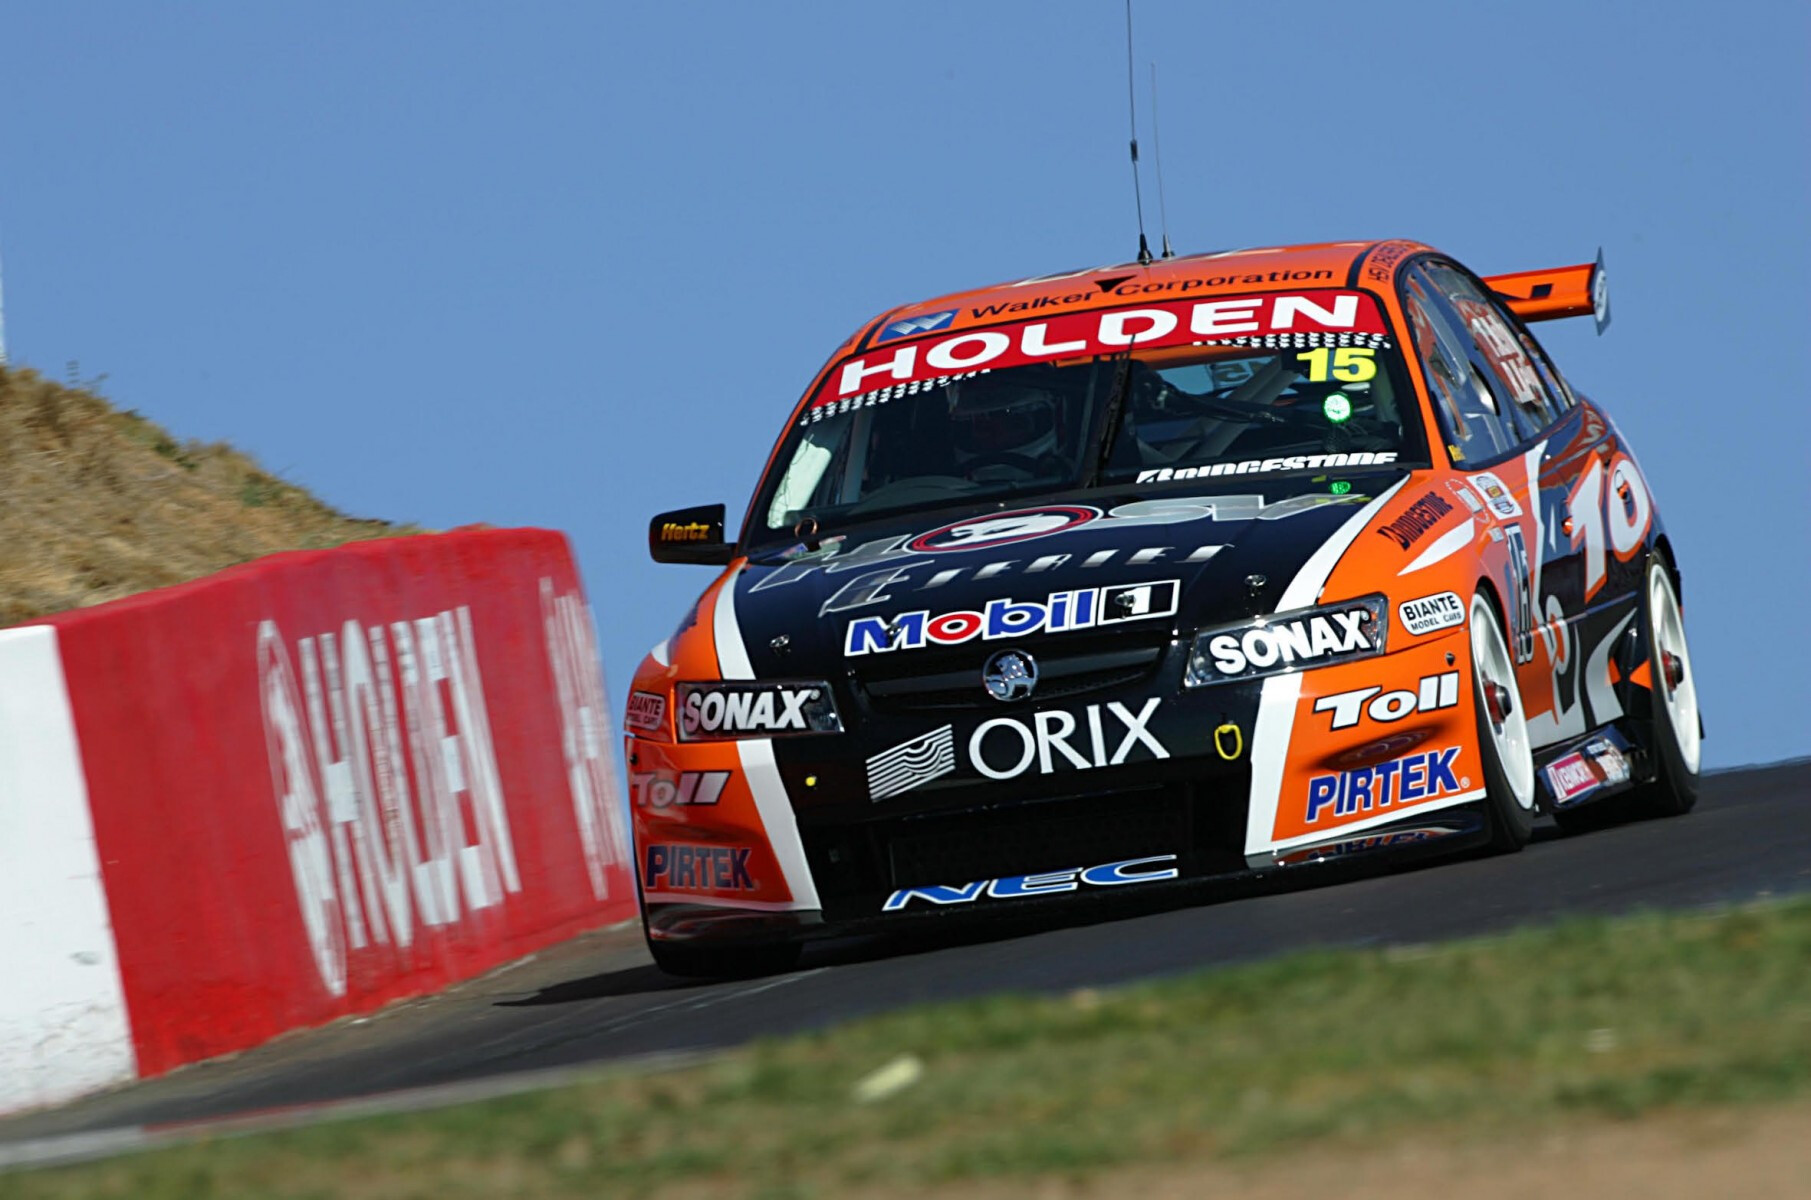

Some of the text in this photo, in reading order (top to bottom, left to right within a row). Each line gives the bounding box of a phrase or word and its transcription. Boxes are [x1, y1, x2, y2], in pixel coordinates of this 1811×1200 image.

[970, 269, 1335, 319] Walker Corporation
[838, 295, 1360, 396] HOLDEN
[1296, 347, 1378, 383] 15
[661, 522, 711, 541] Hertz
[844, 587, 1099, 657] Mobil
[1403, 594, 1459, 622] BIANTE
[1410, 617, 1440, 632] MODEL
[1209, 609, 1372, 675] SONAX
[681, 688, 813, 733] SONAX
[1312, 670, 1461, 732] Toll
[968, 697, 1171, 780] ORIX
[630, 770, 732, 808] Toll
[1304, 745, 1463, 824] PIRTEK
[645, 843, 755, 891] PIRTEK
[881, 854, 1178, 911] NEC
